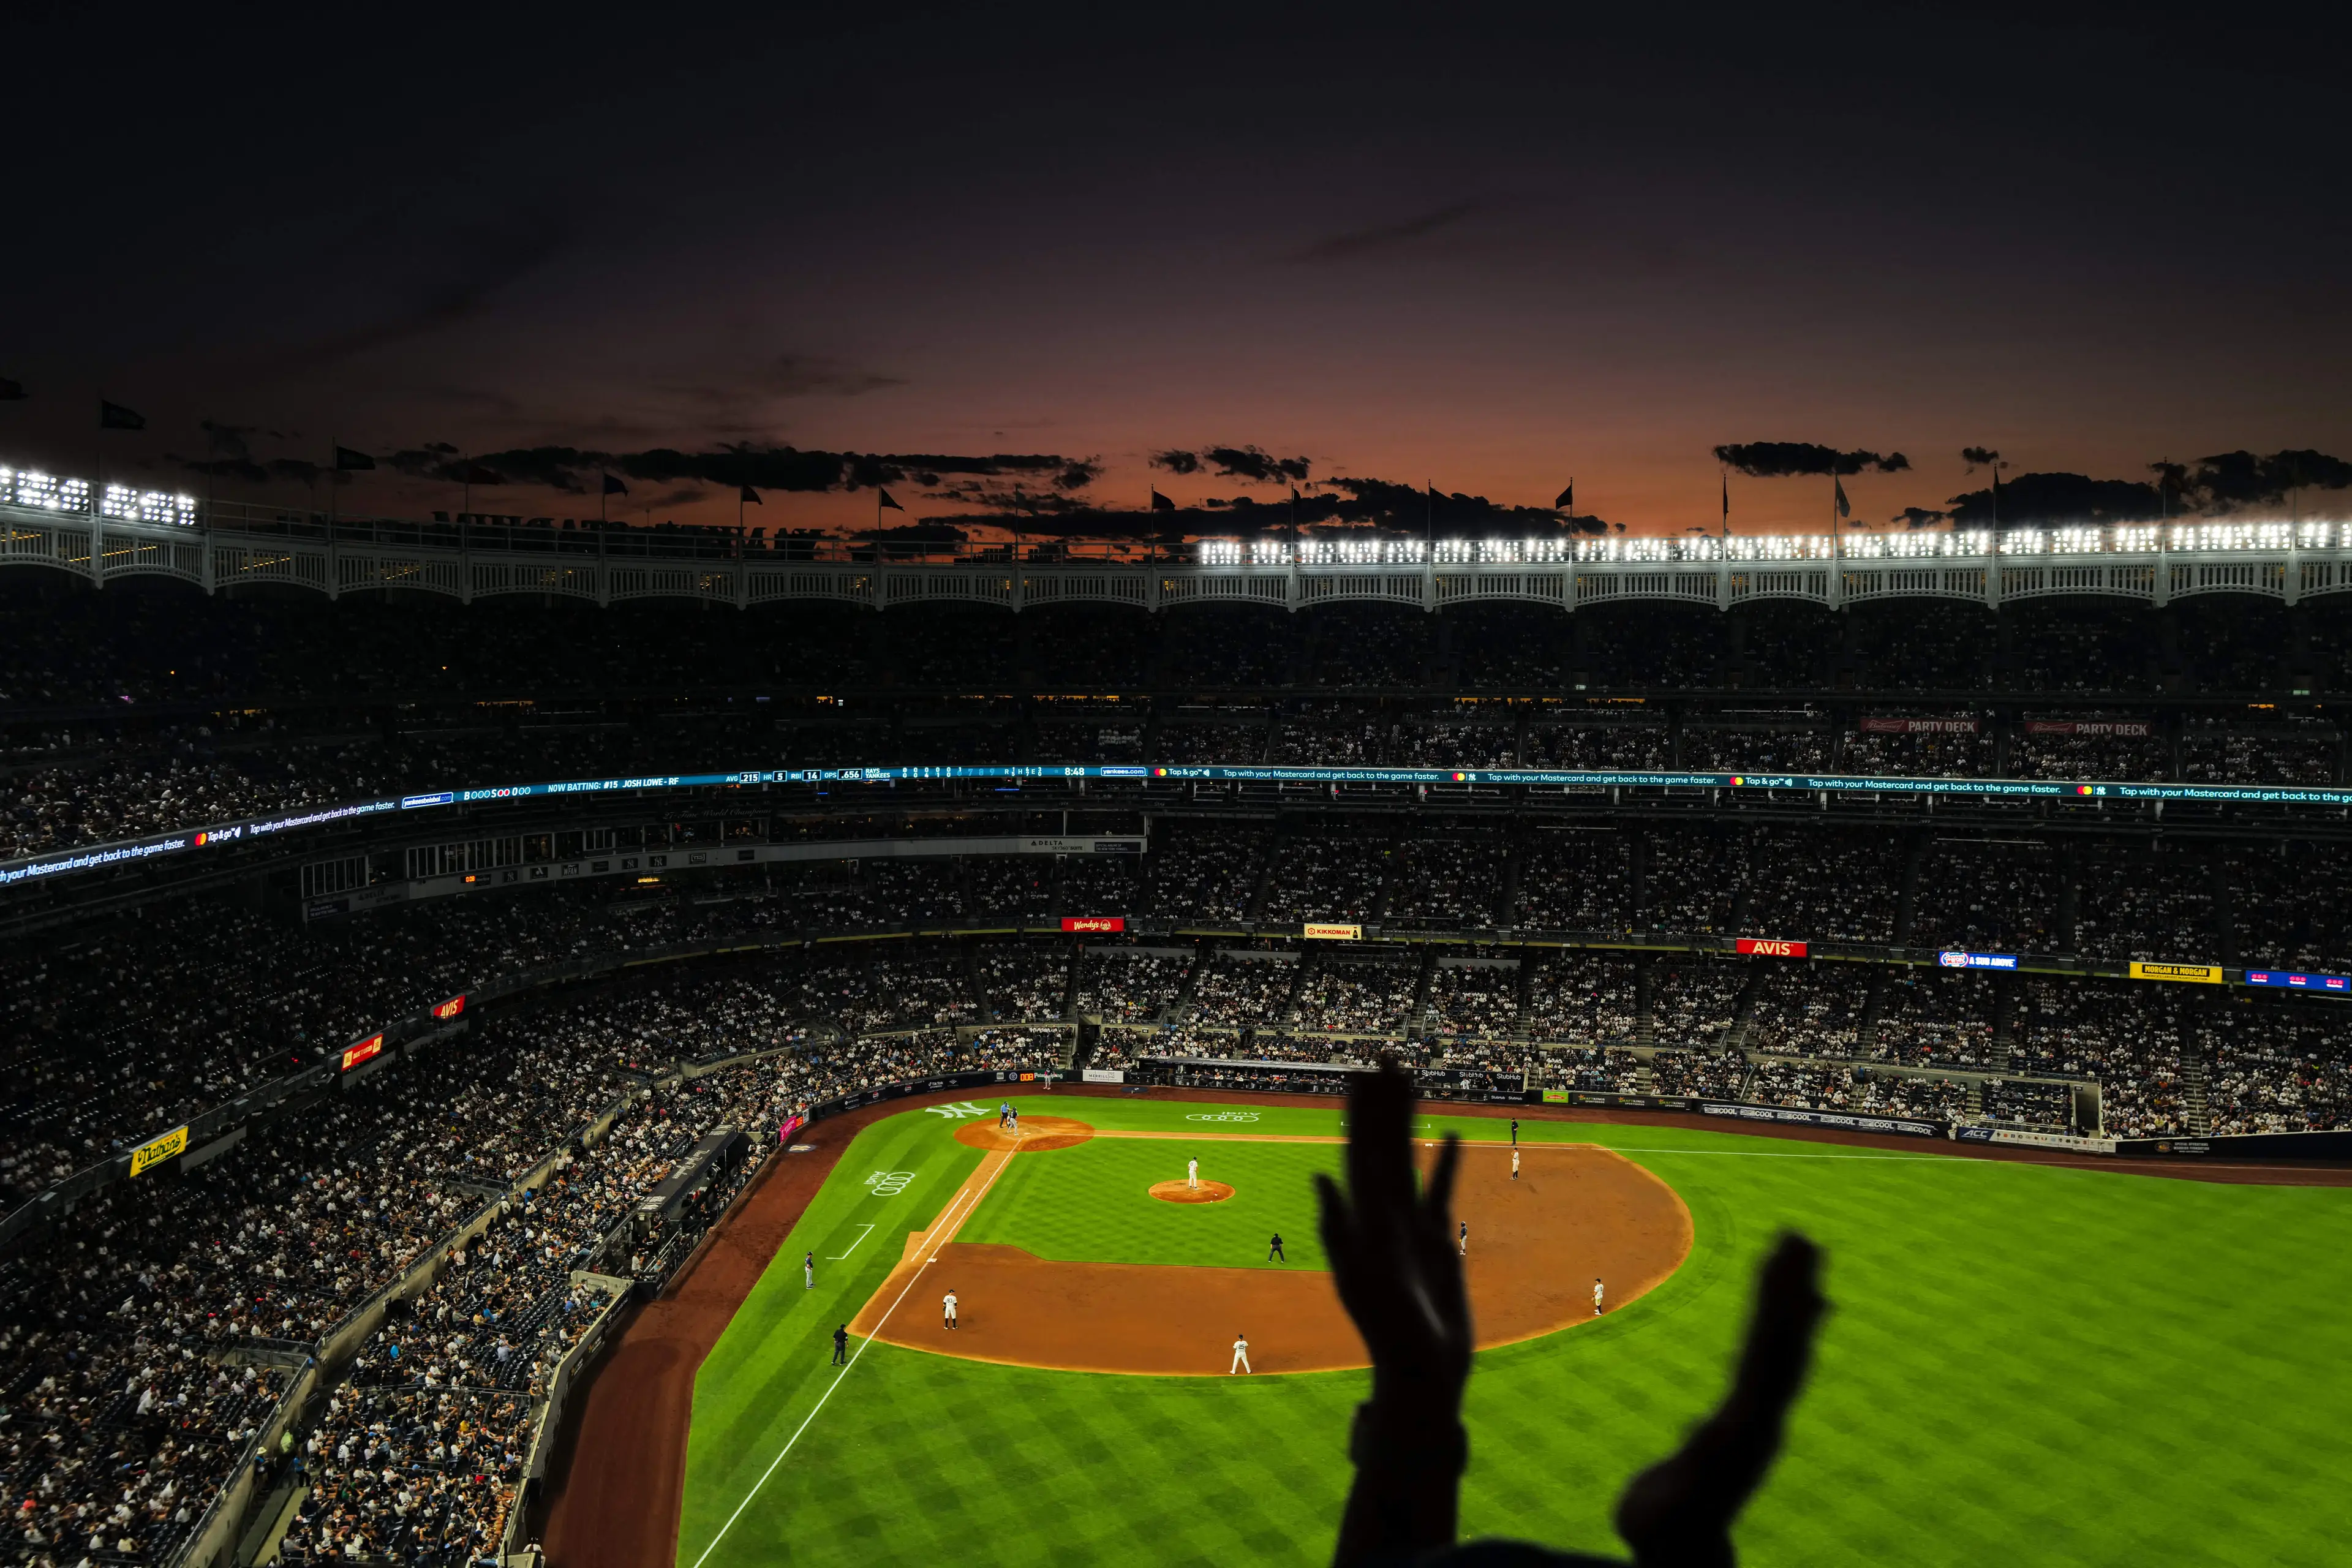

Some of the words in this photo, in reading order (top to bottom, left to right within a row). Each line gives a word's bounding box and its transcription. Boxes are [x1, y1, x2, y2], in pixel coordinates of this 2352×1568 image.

[1909, 721, 1943, 732] PARTY
[1945, 722, 1975, 733] DECK
[2076, 723, 2113, 734] PARTY
[2116, 724, 2147, 736] DECK
[1065, 767, 1085, 776] 8:48
[1223, 769, 1236, 778] Tap
[741, 774, 758, 782] .215
[1745, 777, 1760, 786] Tap
[1808, 779, 1823, 788] Tap
[548, 783, 566, 793] NOW
[567, 782, 601, 791] BATTING:
[603, 780, 618, 790] #15
[622, 779, 642, 788] JOSH
[643, 778, 663, 787] LOWE
[2119, 787, 2137, 796] Tap
[2185, 789, 2239, 798] Mastercard
[404, 796, 451, 807] yankeesbeisbol.com
[703, 809, 727, 817] World
[729, 807, 772, 818] Champions
[250, 824, 260, 835] Tap
[260, 821, 273, 831] with
[273, 821, 284, 832] your
[284, 813, 313, 827] Mastercard
[312, 813, 322, 823] and
[322, 812, 331, 821] get
[331, 810, 342, 818] back
[348, 806, 356, 815] the
[356, 804, 374, 815] game
[375, 802, 394, 810] faster.
[208, 832, 219, 842] Tap
[219, 829, 224, 839] &
[6, 869, 26, 883] your
[26, 858, 74, 876] Mastercard
[73, 854, 89, 867] and
[88, 854, 103, 867] get
[103, 849, 122, 862] back
[122, 849, 130, 858] to
[131, 846, 143, 856] the
[143, 844, 163, 856] game
[164, 840, 185, 850] faster.
[1074, 920, 1099, 930] Wendy's
[1752, 941, 1790, 956] AVIS
[1975, 957, 1990, 965] SUB
[1991, 957, 2015, 967] ABOVE
[2144, 965, 2172, 974] MORGAN
[2179, 968, 2207, 976] MORGAN
[441, 999, 458, 1016] AVIS
[1913, 1126, 1933, 1136] COOL
[138, 1134, 181, 1165] Nathan's
[863, 1171, 886, 1185] Audi
